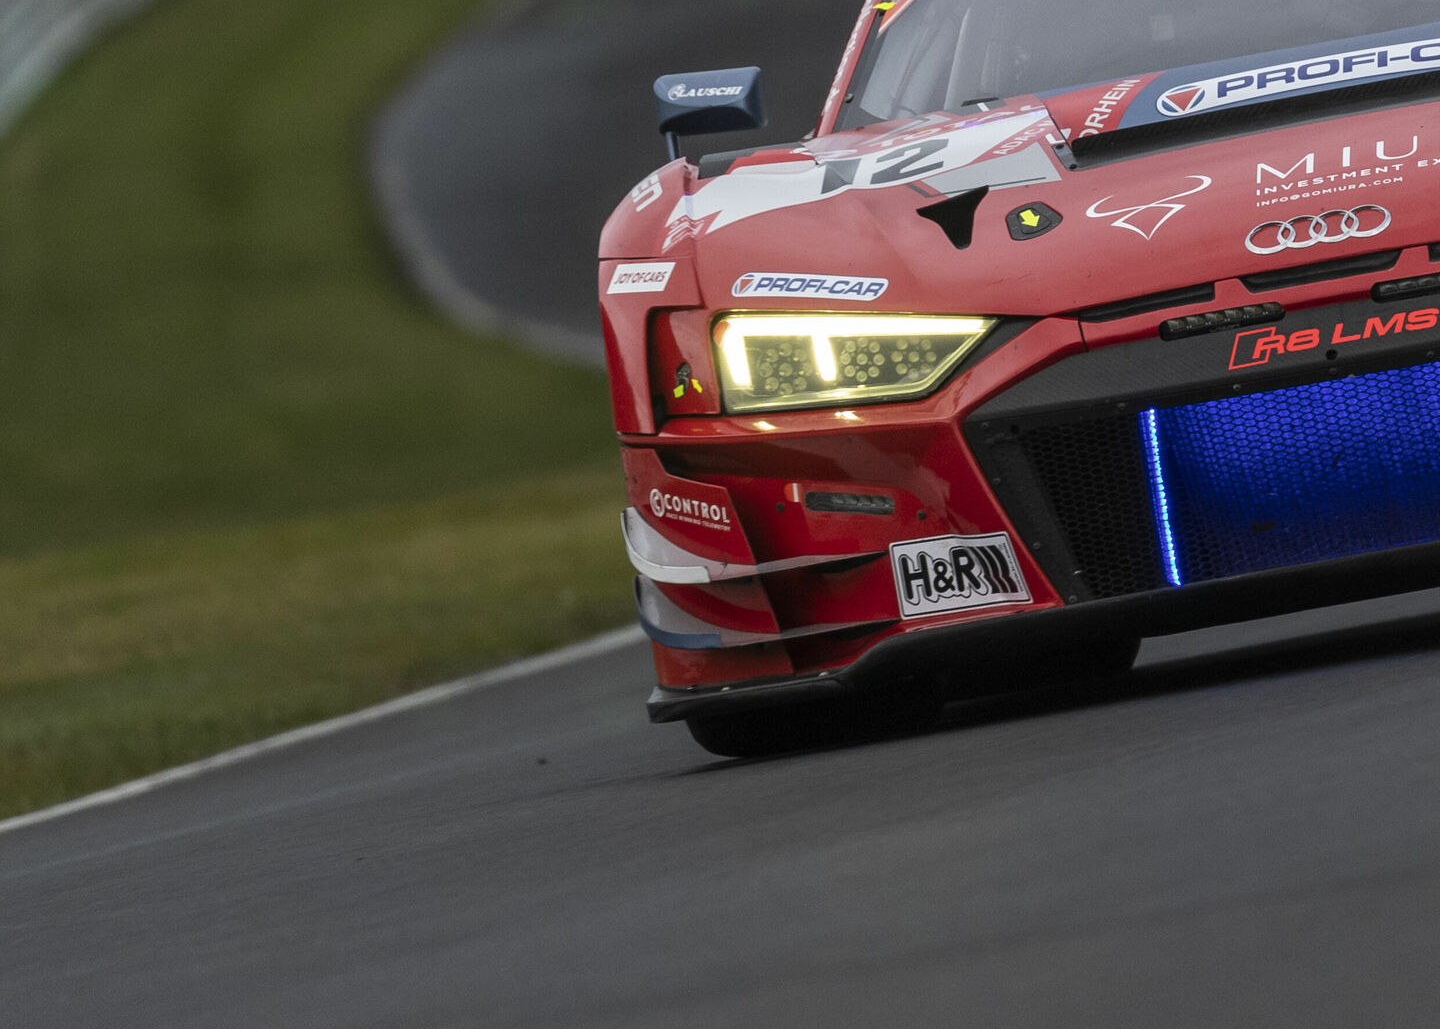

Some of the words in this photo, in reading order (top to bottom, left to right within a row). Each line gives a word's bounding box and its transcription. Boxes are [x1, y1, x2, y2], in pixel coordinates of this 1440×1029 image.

[677, 85, 743, 98] LAUSCHI
[820, 138, 950, 195] 12
[1256, 164, 1403, 196] INVESTMENT
[1256, 176, 1403, 207] INFO@GOMIURA.COM
[614, 272, 632, 285] JOY
[753, 277, 885, 297] PROFI-CAR
[1331, 308, 1440, 345] LMS
[664, 494, 731, 523] CONTROL
[900, 548, 983, 602] H&R
